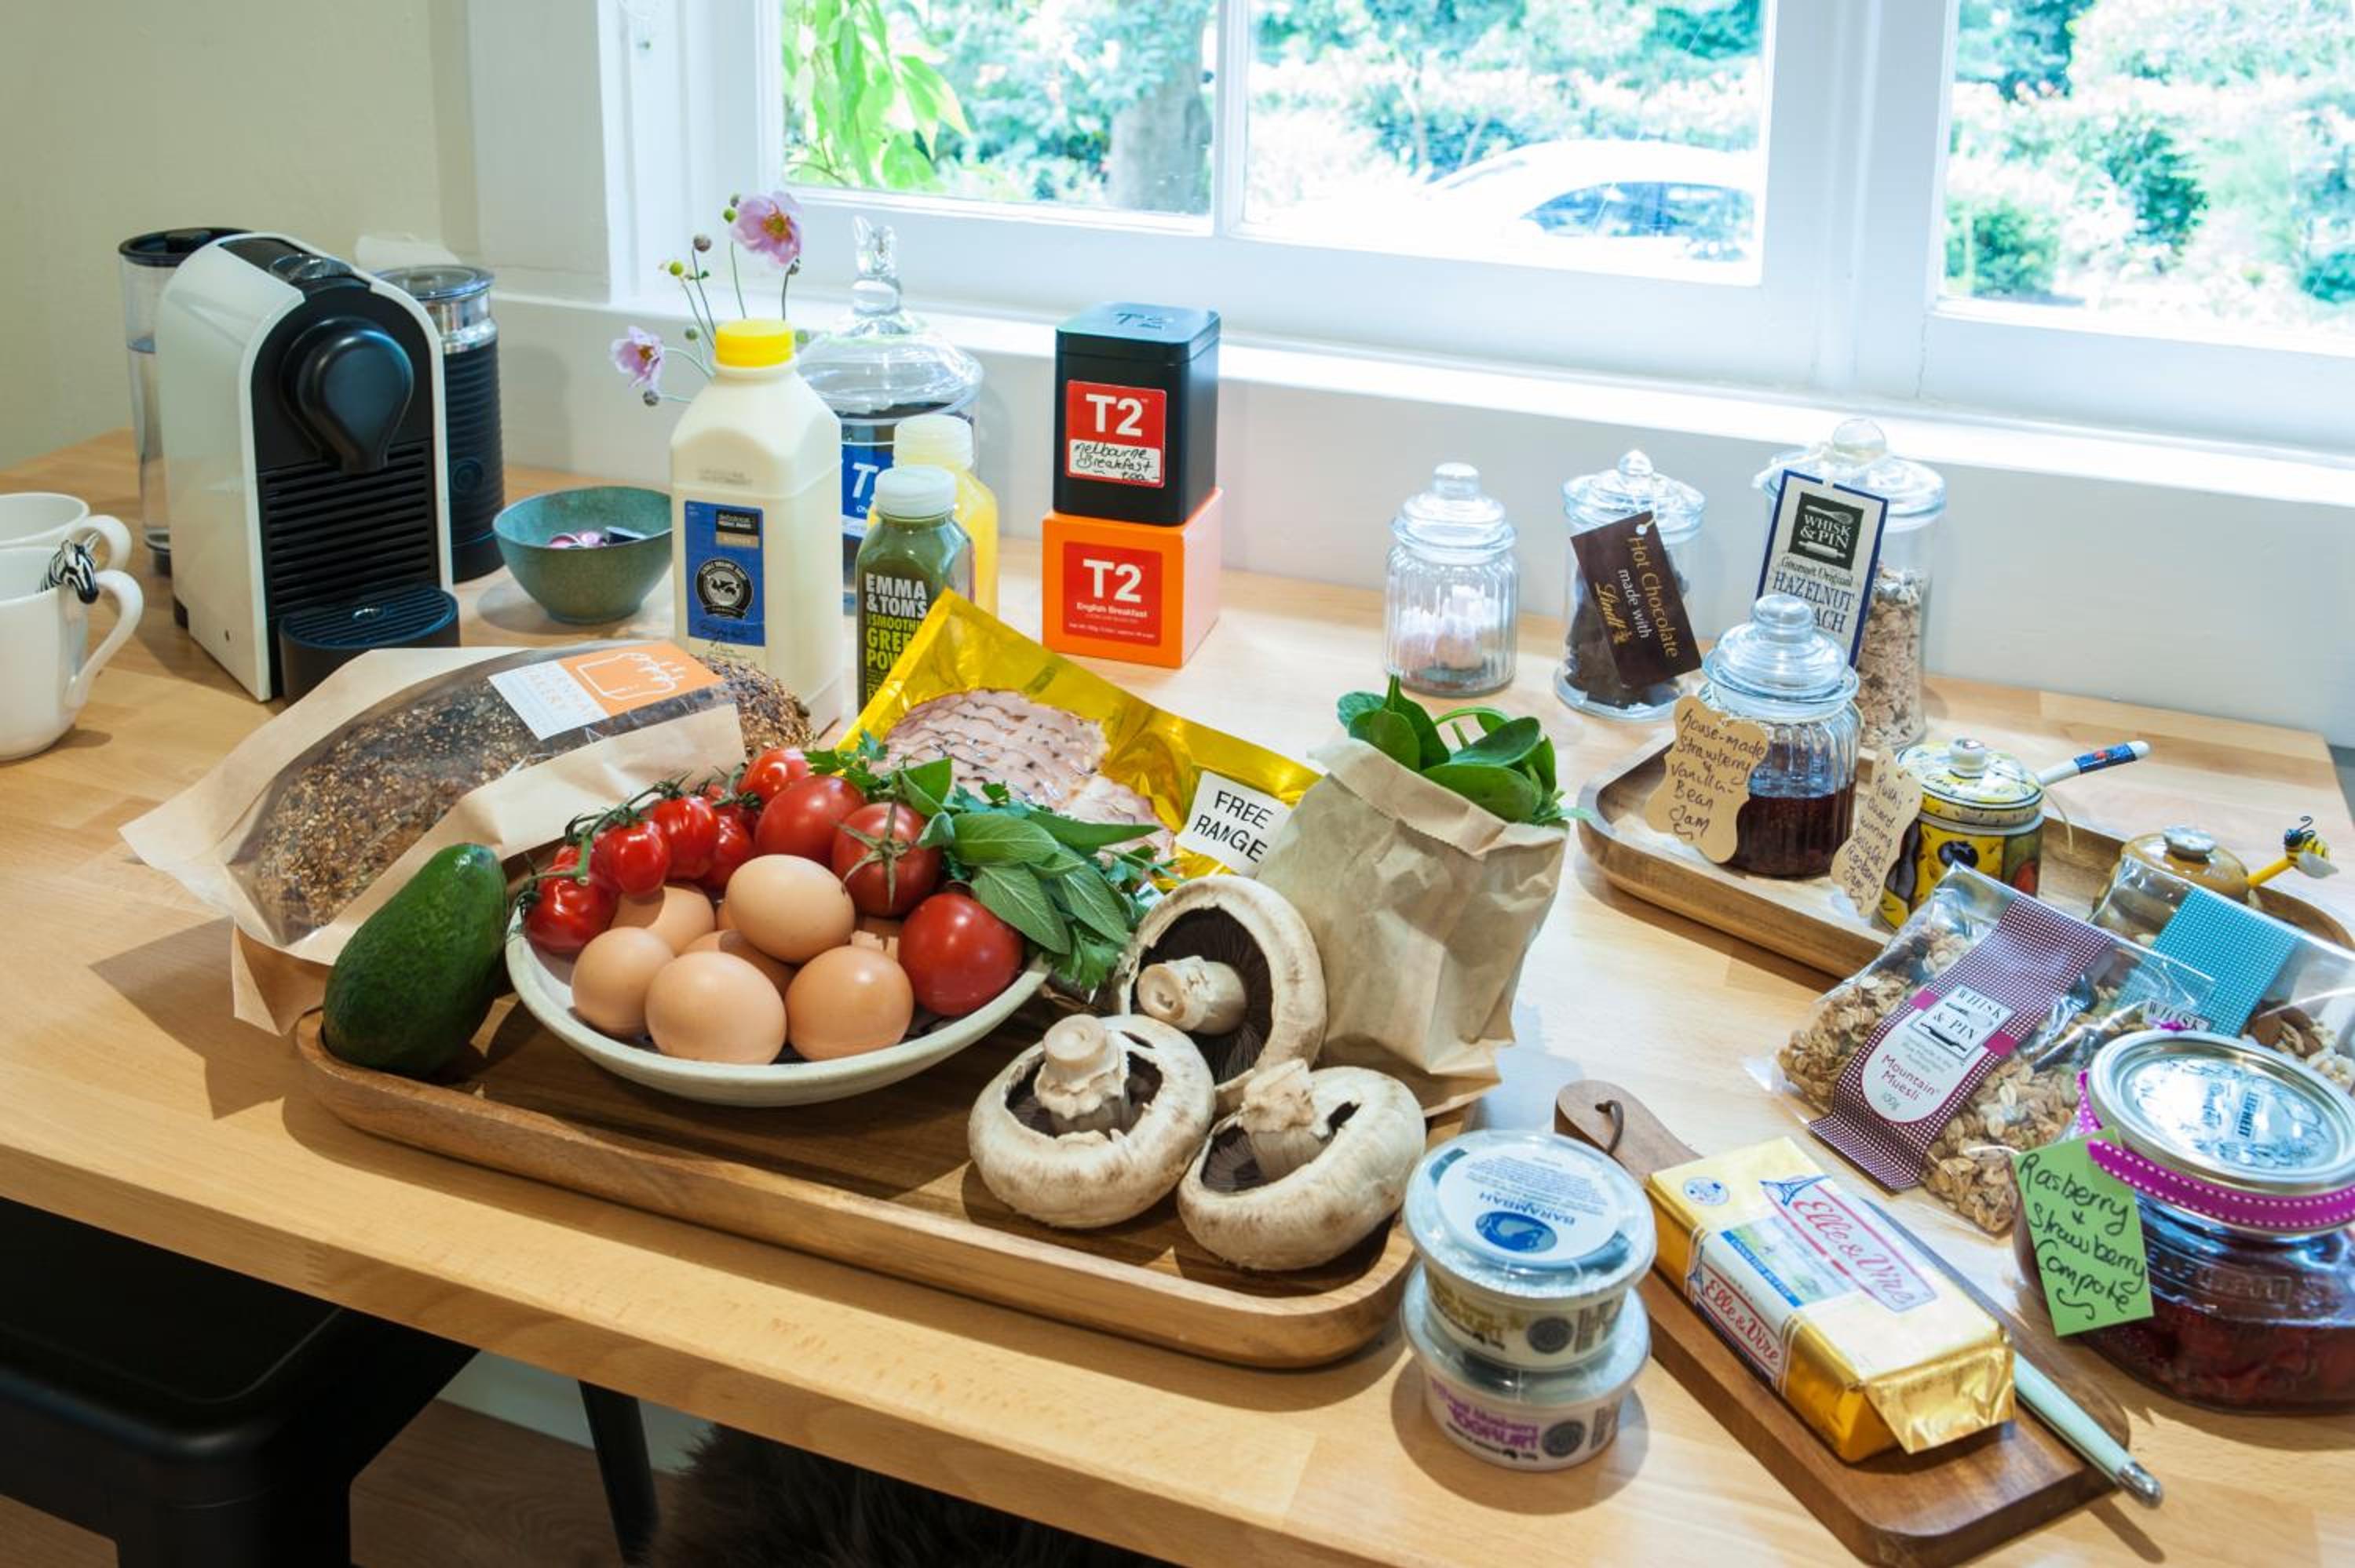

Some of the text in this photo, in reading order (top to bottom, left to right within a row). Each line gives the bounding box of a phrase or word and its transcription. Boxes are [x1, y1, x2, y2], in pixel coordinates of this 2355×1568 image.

[1086, 393, 1143, 437] T2
[853, 462, 878, 502] T
[1804, 514, 1851, 538] WHISK
[1818, 530, 1849, 549] PIN
[866, 572, 926, 600] EMMA
[1083, 558, 1142, 603] T2
[1629, 537, 1678, 658] Hot Chocolate
[1773, 571, 1855, 612] HAZELNUT
[1076, 602, 1148, 618] English Breakfast
[1618, 569, 1652, 639] made with
[1214, 790, 1274, 830] FREE
[1669, 805, 1711, 837] Jam
[1193, 815, 1269, 863] RANGE
[1959, 989, 2003, 1019] WHISK
[1949, 1019, 1976, 1040] PIN
[1882, 1054, 1936, 1096] Mountain
[1882, 1070, 1920, 1102] Muesli
[1479, 1191, 1575, 1226] BARAMBAH
[2019, 1152, 2129, 1236] Rasberry
[2028, 1202, 2145, 1295] Strawberry
